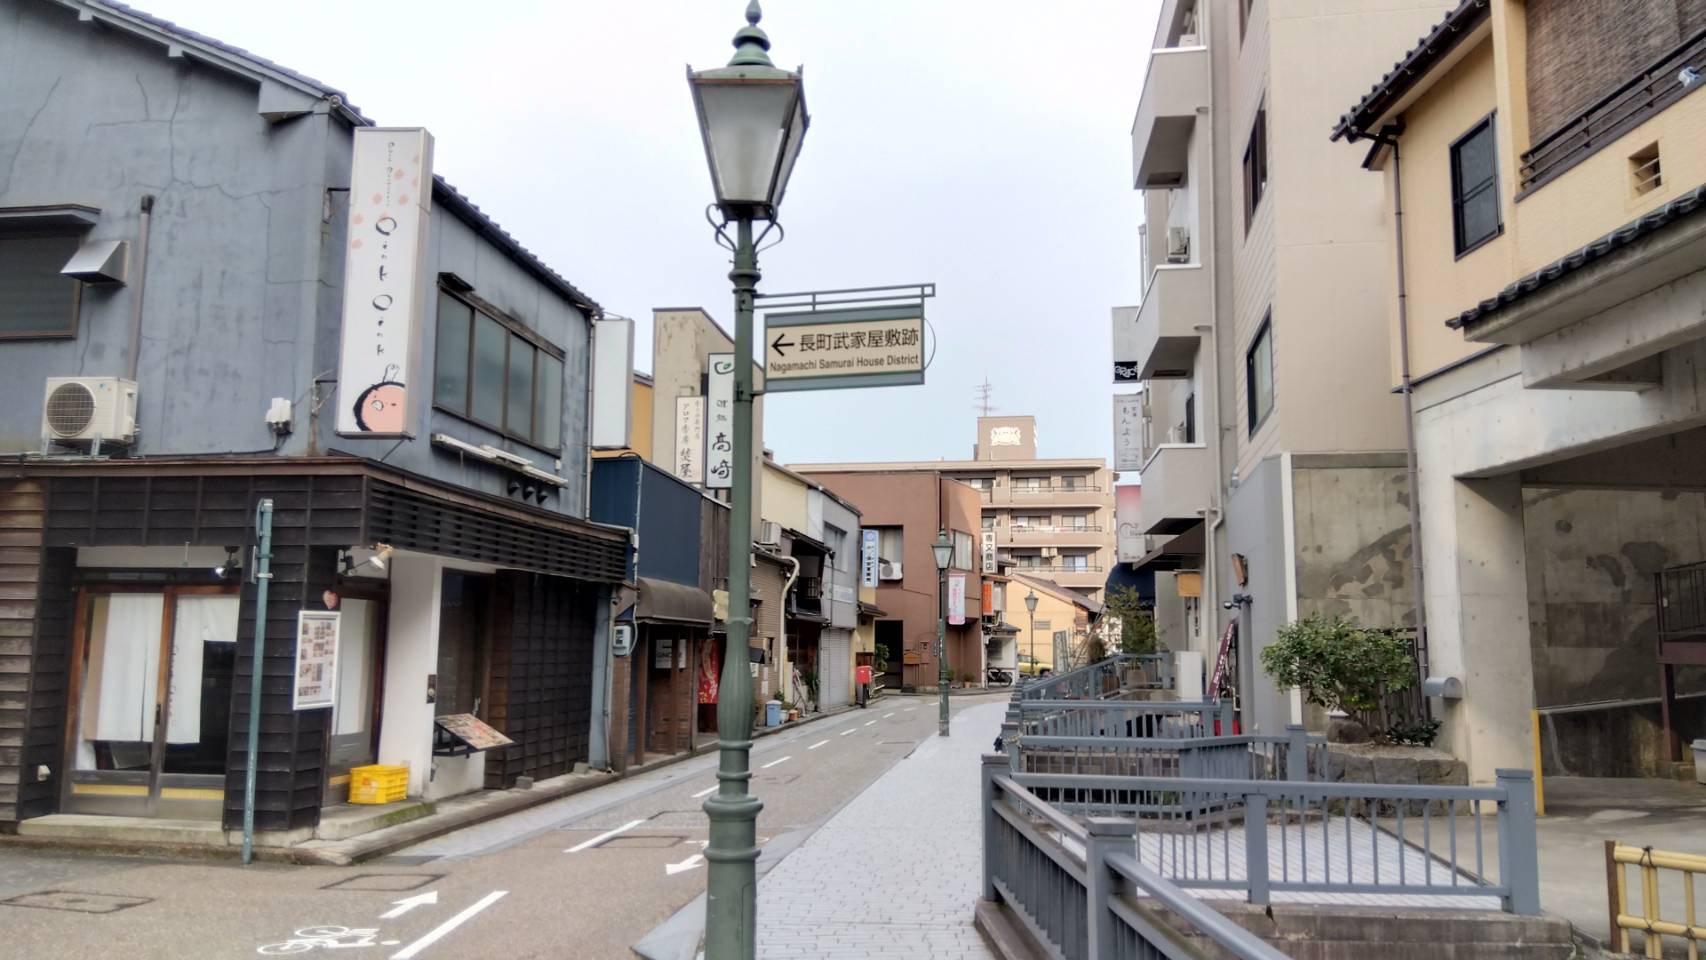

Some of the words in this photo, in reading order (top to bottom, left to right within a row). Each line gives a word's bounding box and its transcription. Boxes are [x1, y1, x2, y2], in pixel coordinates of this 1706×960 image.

[799, 327, 919, 352] 長町武家屋敷跡
[770, 359, 817, 374] Nagamachi
[819, 357, 854, 369] Samurai
[856, 356, 884, 367] House
[886, 354, 919, 366] District
